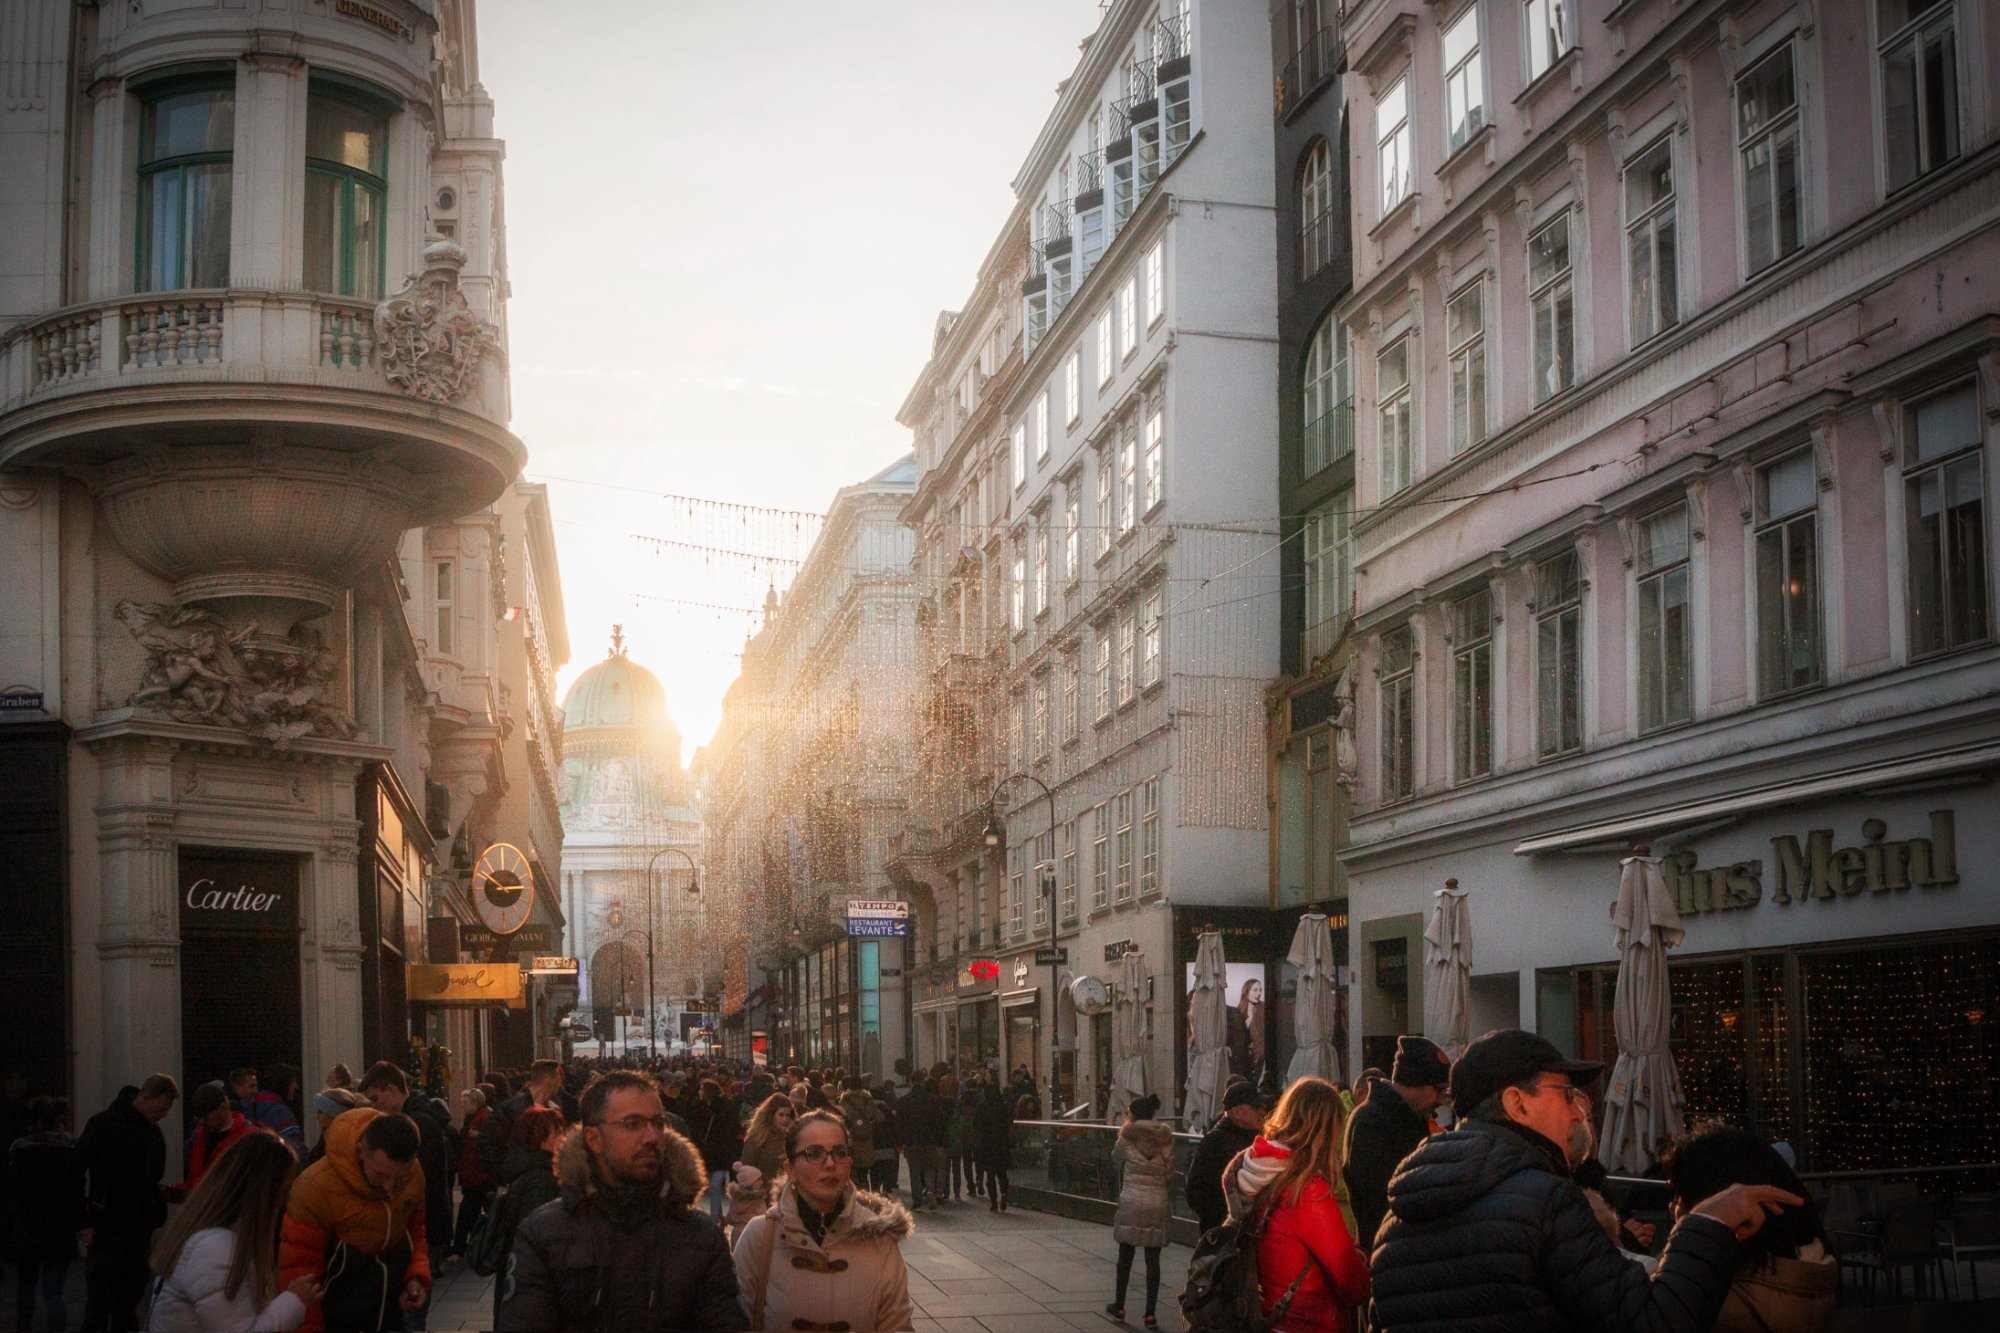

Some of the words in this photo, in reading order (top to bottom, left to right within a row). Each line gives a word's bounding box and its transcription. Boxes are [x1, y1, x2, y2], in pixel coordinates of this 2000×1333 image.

[1770, 809, 1960, 905] Meinl
[187, 878, 281, 911] Cartier
[850, 919, 892, 927] RESTAURANT
[850, 926, 893, 936] LEVANTE
[511, 932, 544, 942] RMANI
